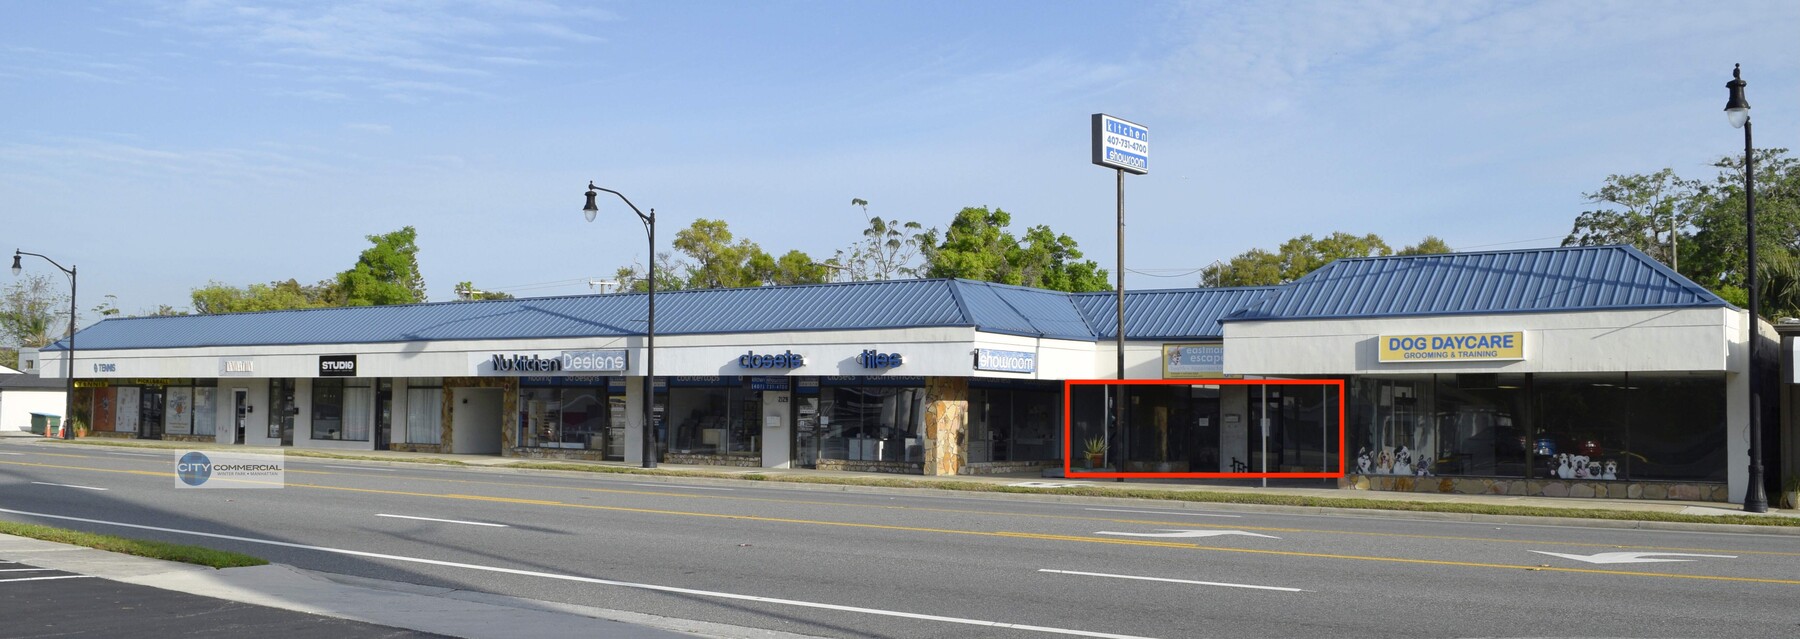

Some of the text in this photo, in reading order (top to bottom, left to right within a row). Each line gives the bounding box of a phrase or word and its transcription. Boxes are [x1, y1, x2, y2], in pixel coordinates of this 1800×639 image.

[1107, 120, 1147, 142] kitchen
[1107, 136, 1146, 153] 407-731-4700
[1109, 149, 1145, 167] showroom
[1389, 335, 1514, 350] DOG DAYCARE
[512, 353, 561, 371] kitchen
[563, 353, 624, 369] Designs
[738, 350, 804, 368] closets
[861, 350, 903, 368] tiles
[979, 351, 1033, 369] showroom
[1458, 350, 1498, 358] TRAINING
[99, 363, 116, 372] TENNIS
[322, 361, 354, 370] STUDIO
